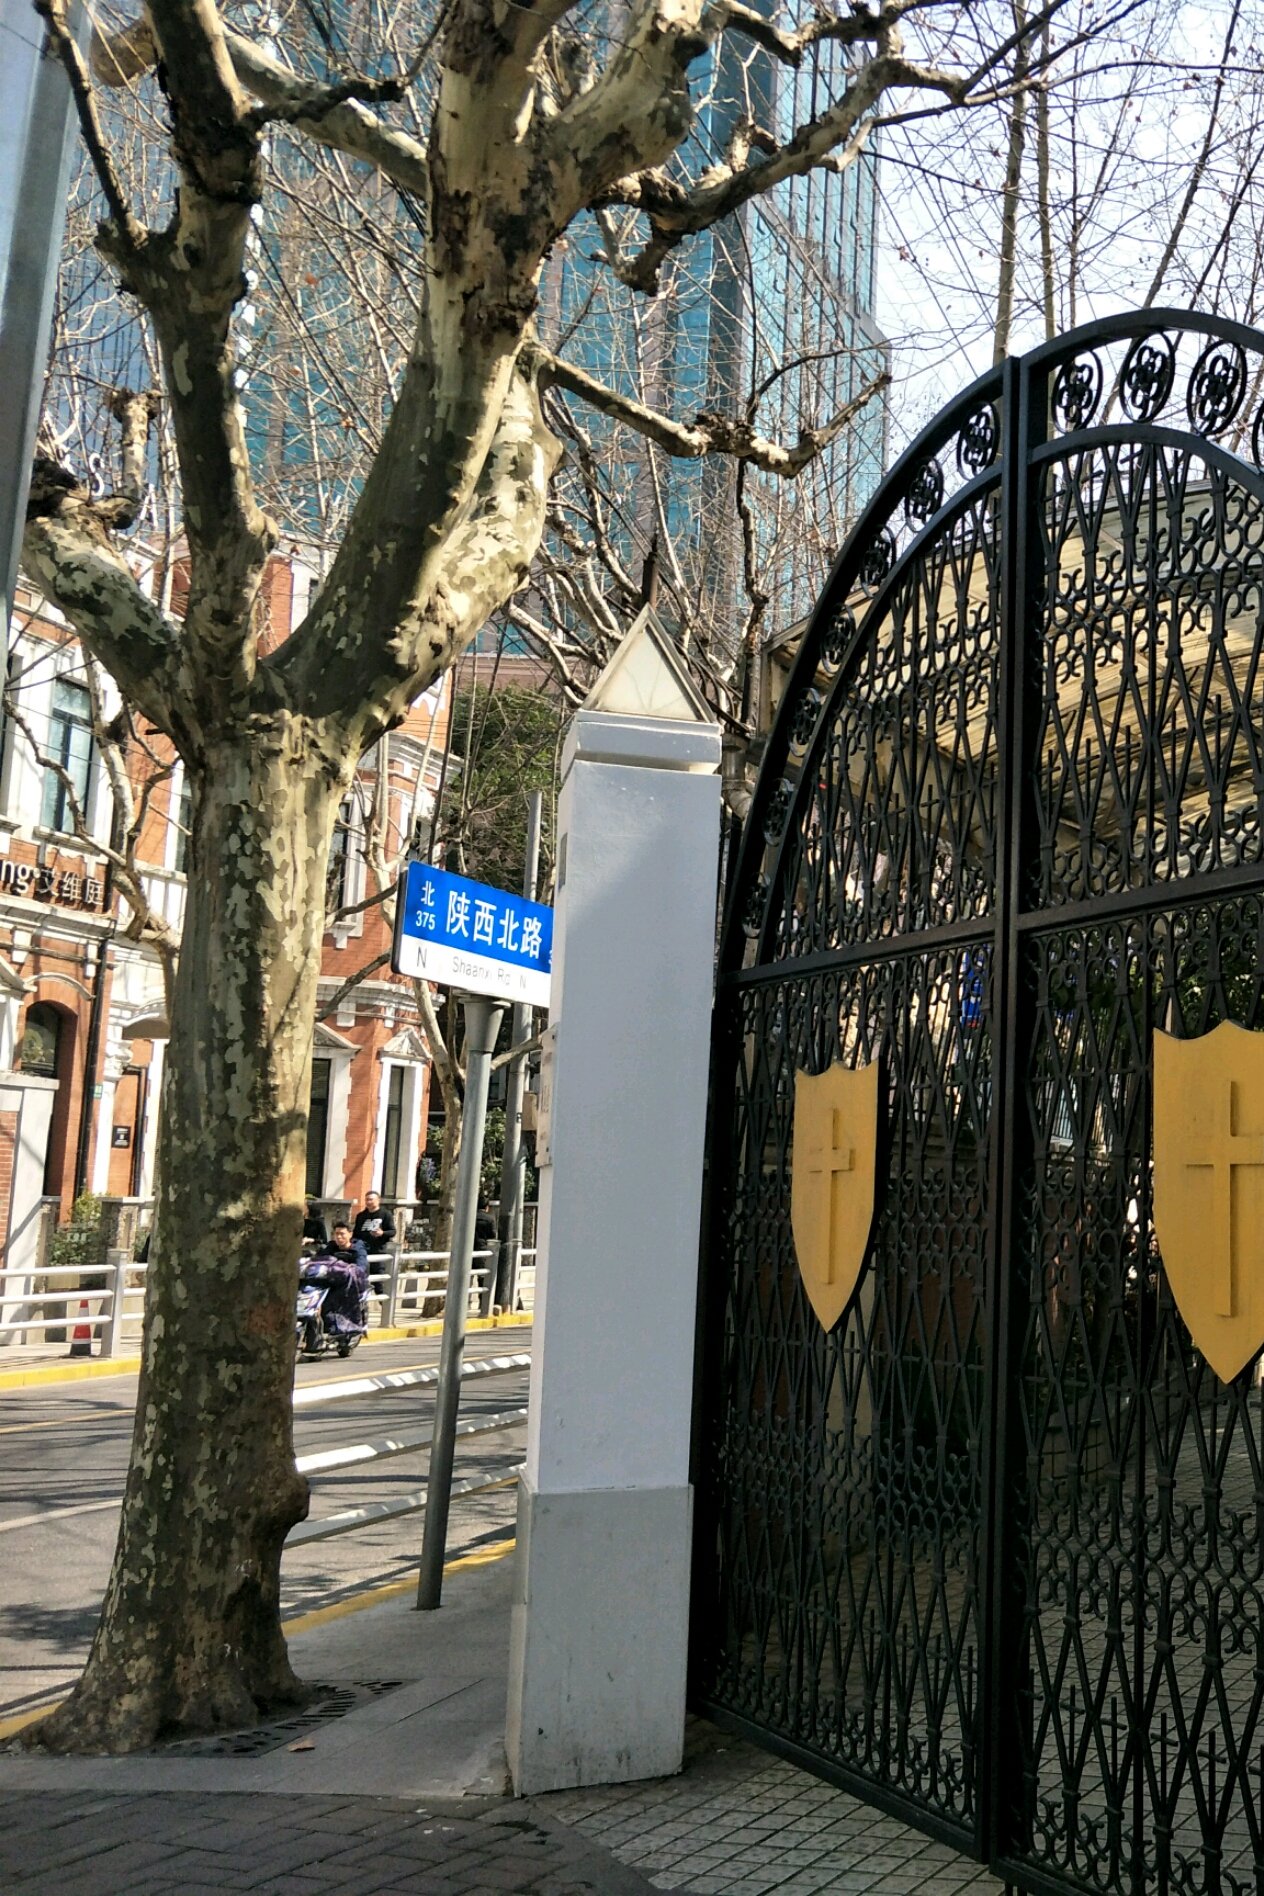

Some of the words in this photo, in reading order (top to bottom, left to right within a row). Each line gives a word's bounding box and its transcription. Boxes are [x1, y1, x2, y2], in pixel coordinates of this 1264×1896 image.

[421, 880, 436, 907] 北
[415, 910, 436, 931] 375
[446, 890, 542, 960] 陕西北路
[416, 946, 427, 969] N
